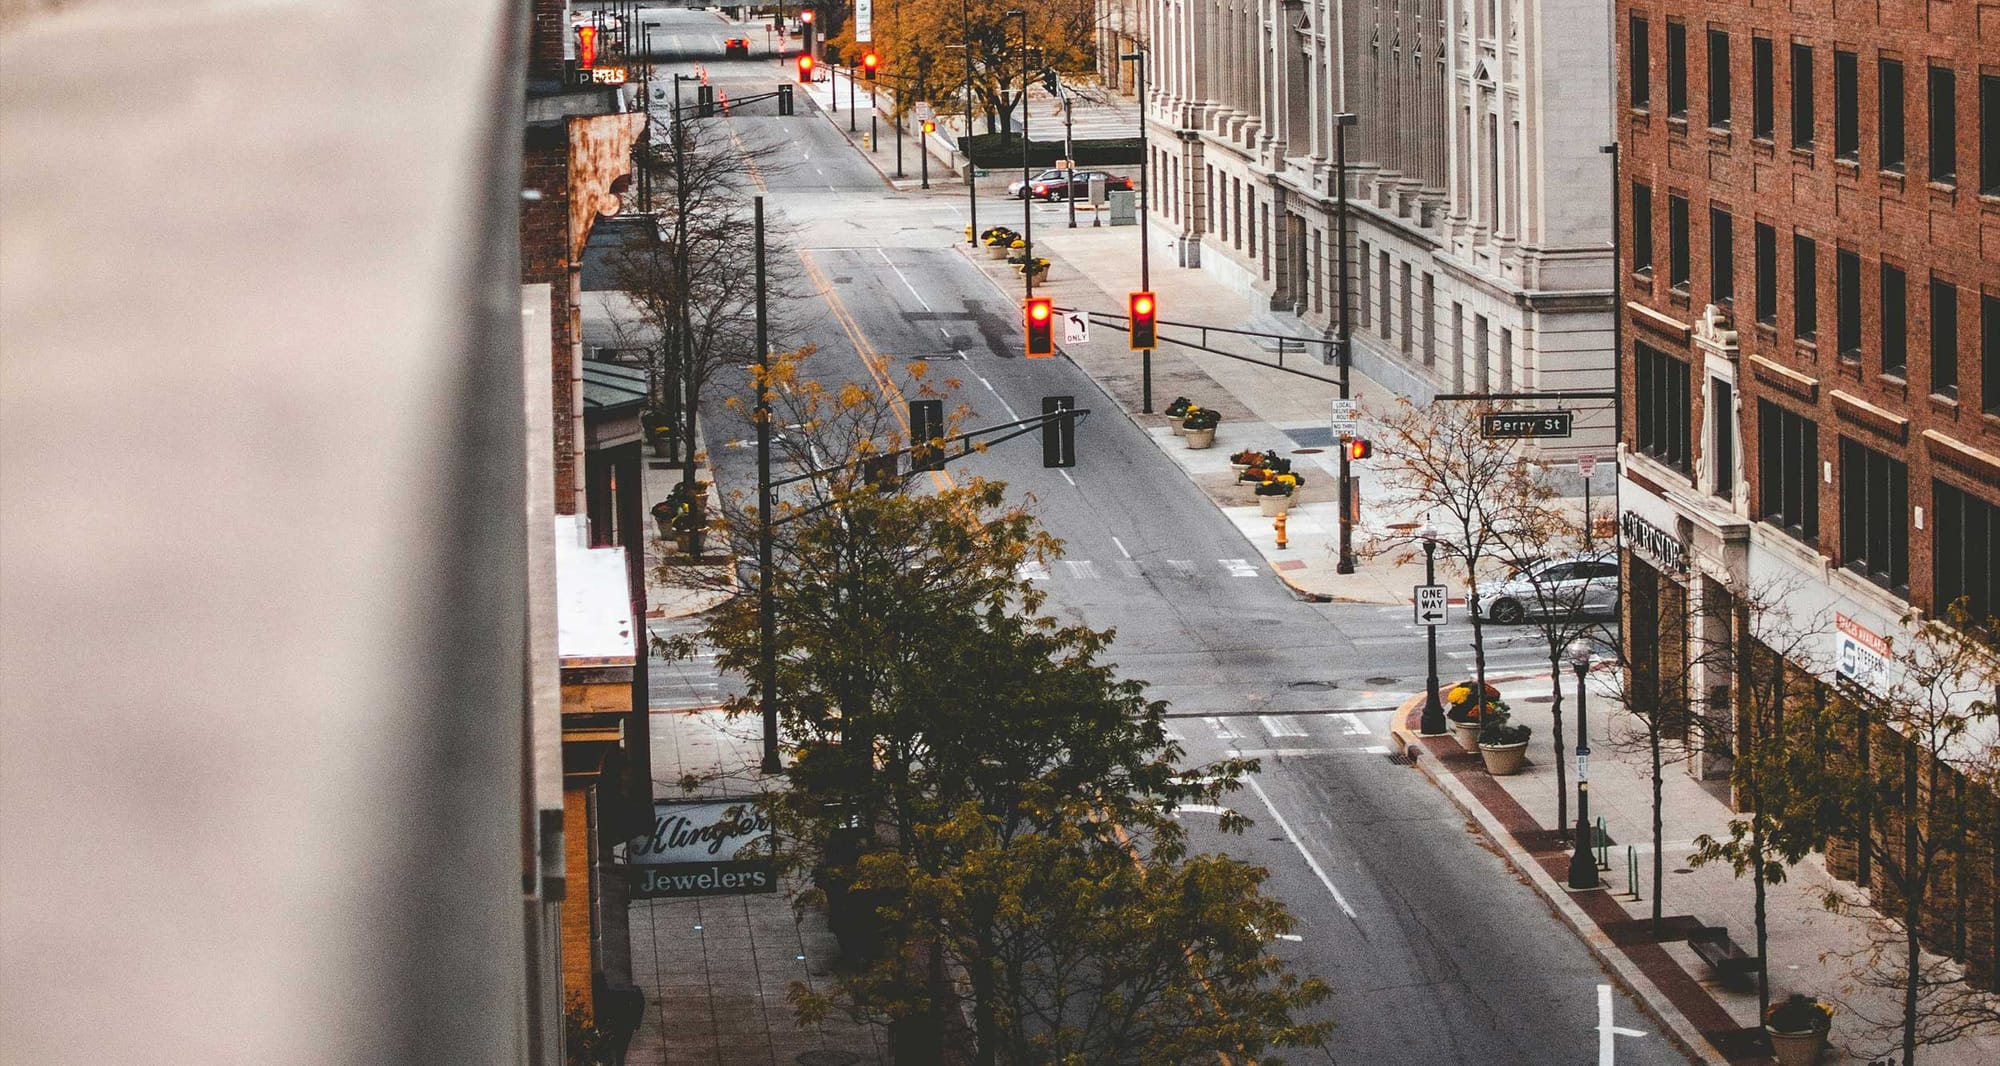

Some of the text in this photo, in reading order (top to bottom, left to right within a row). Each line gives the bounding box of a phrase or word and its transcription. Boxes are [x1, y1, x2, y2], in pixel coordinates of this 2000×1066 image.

[1492, 419, 1560, 433] Berry St
[1422, 589, 1443, 599] ONE
[1421, 599, 1443, 609] WAY
[640, 866, 767, 893] Jewelers
